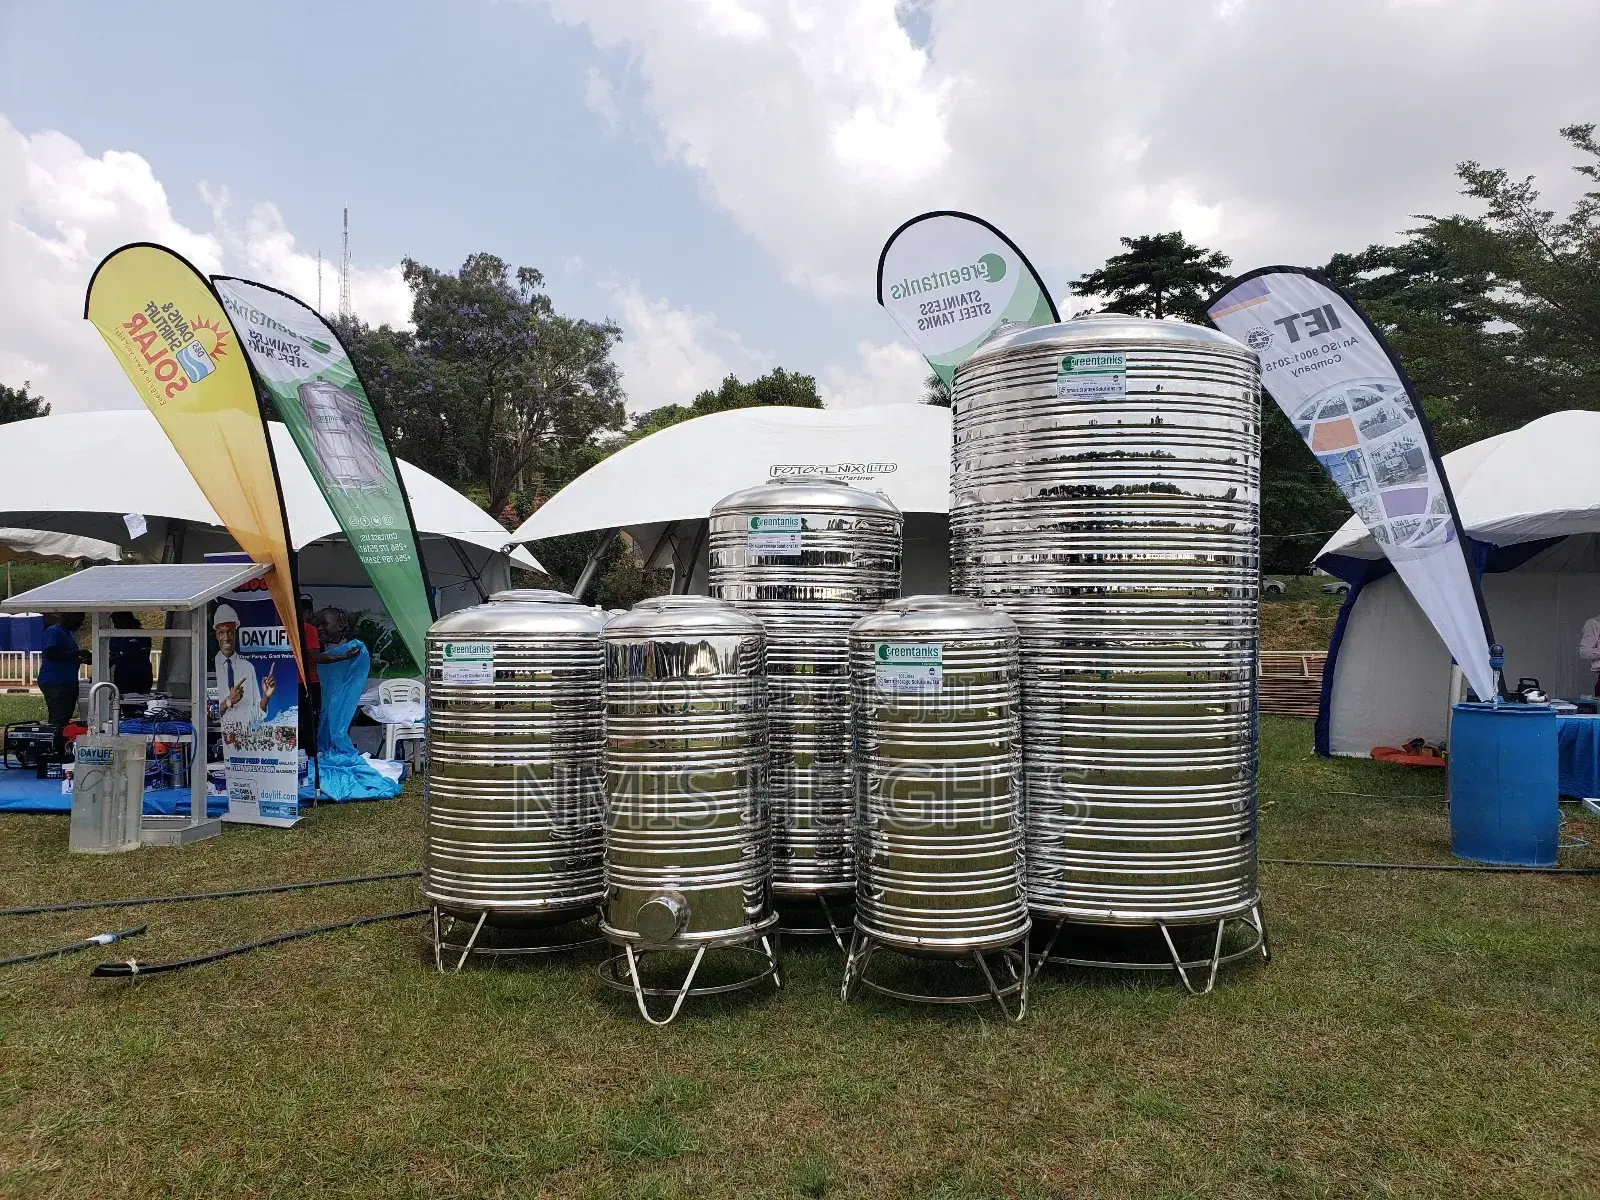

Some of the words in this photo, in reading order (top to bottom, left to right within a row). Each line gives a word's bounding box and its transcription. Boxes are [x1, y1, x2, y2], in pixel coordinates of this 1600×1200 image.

[1071, 355, 1123, 369] greentanks
[757, 517, 799, 529] greentanks
[451, 644, 491, 656] greentanks
[886, 646, 939, 659] greentanks
